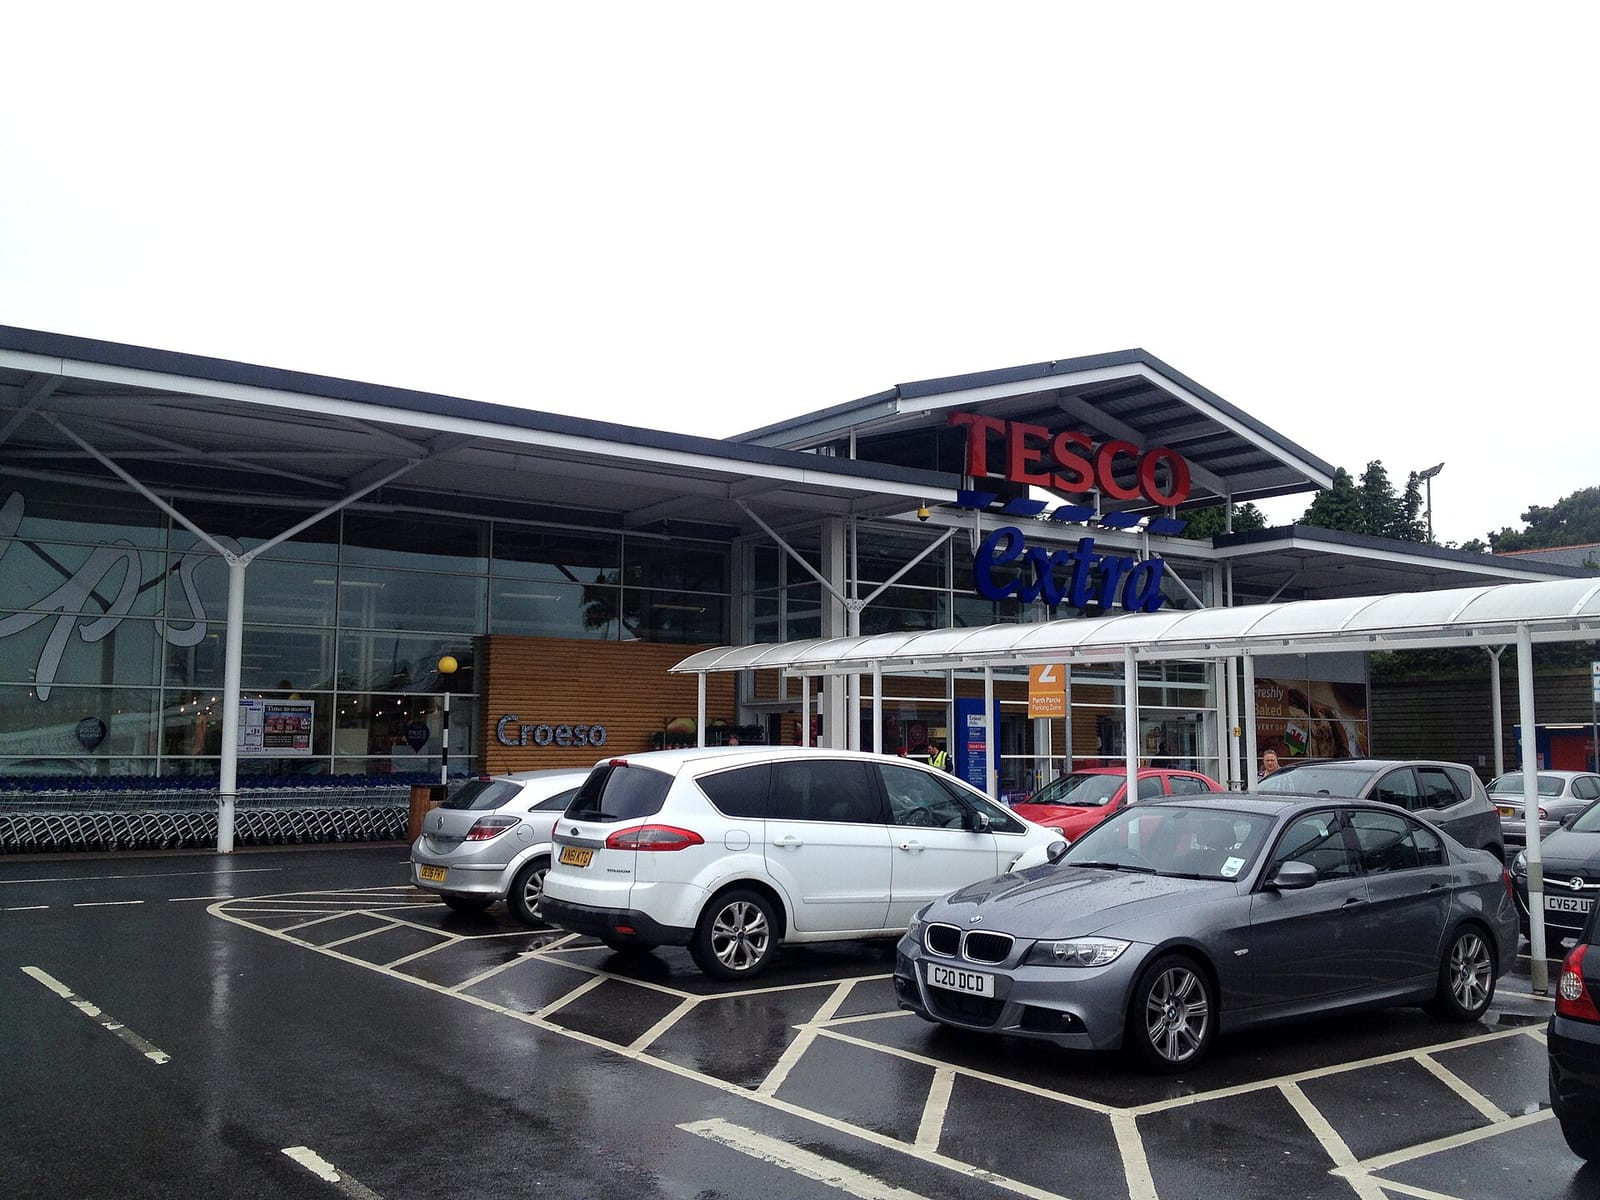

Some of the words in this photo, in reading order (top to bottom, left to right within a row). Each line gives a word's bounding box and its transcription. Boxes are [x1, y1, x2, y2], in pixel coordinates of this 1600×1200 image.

[947, 410, 1192, 507] TESCO
[973, 526, 1168, 613] extra
[1255, 703, 1282, 716] Baked
[497, 713, 608, 747] Croeso
[1550, 897, 1578, 911] CV62
[935, 967, 955, 987] C20
[958, 972, 984, 992] DCD
